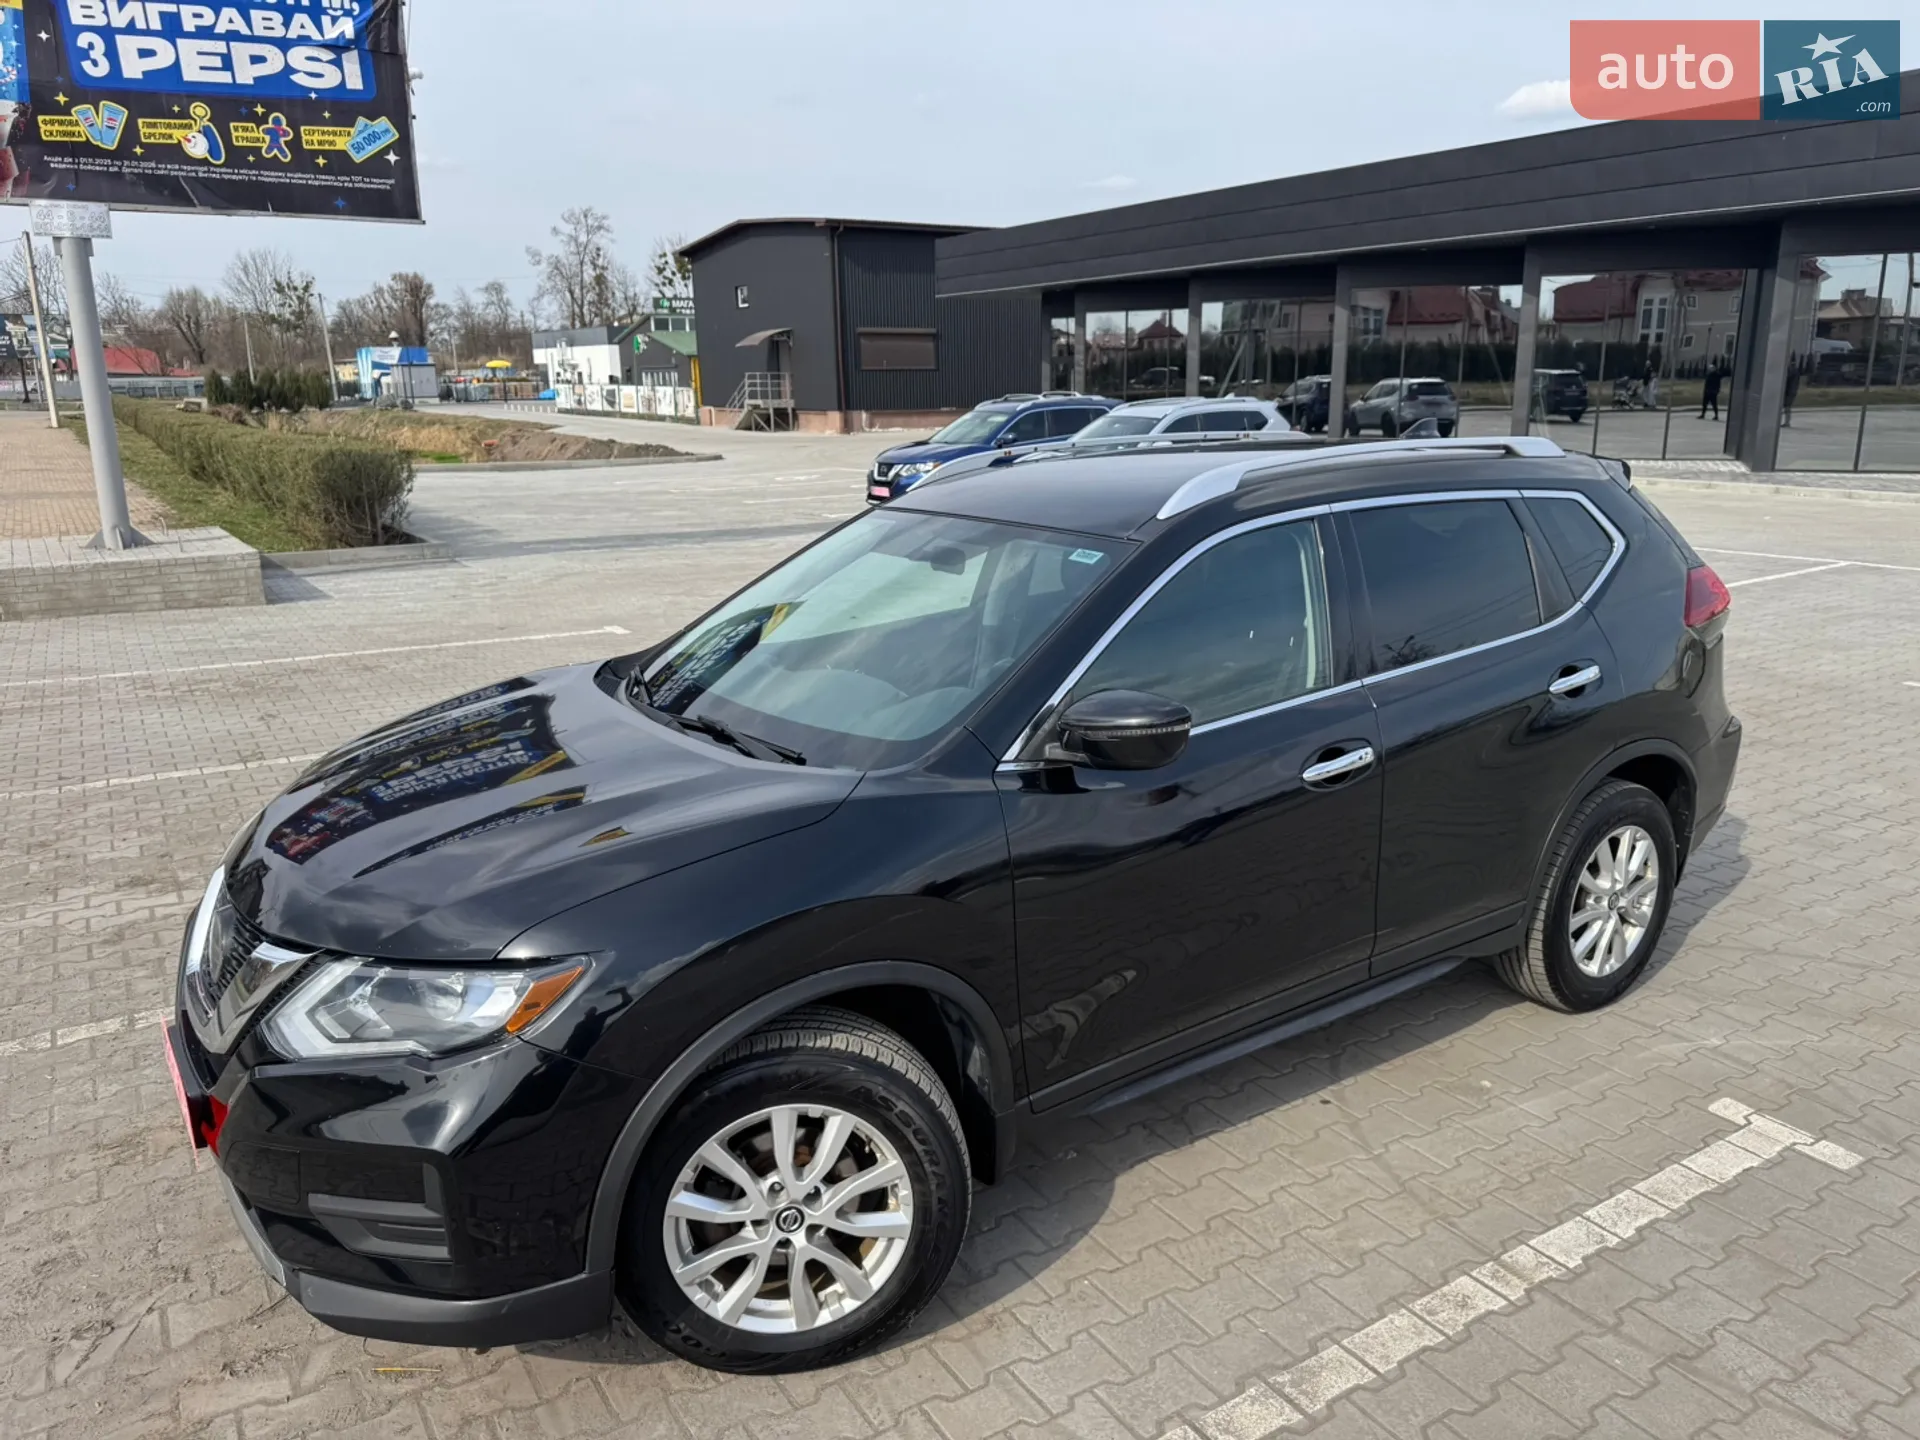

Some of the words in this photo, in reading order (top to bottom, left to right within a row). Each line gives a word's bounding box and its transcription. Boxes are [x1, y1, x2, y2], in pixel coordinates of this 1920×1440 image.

[65, 0, 356, 39] ВИГРАВАЙ
[115, 34, 364, 90] PEPSI
[41, 119, 80, 128] ФІРМОВА
[43, 129, 83, 139] СКЛЯНКА
[143, 132, 174, 141] БРЕЛОК
[235, 135, 266, 144] ІГРАШКА
[305, 139, 315, 147] НА
[350, 142, 365, 154] 50
[363, 130, 381, 147] 000
